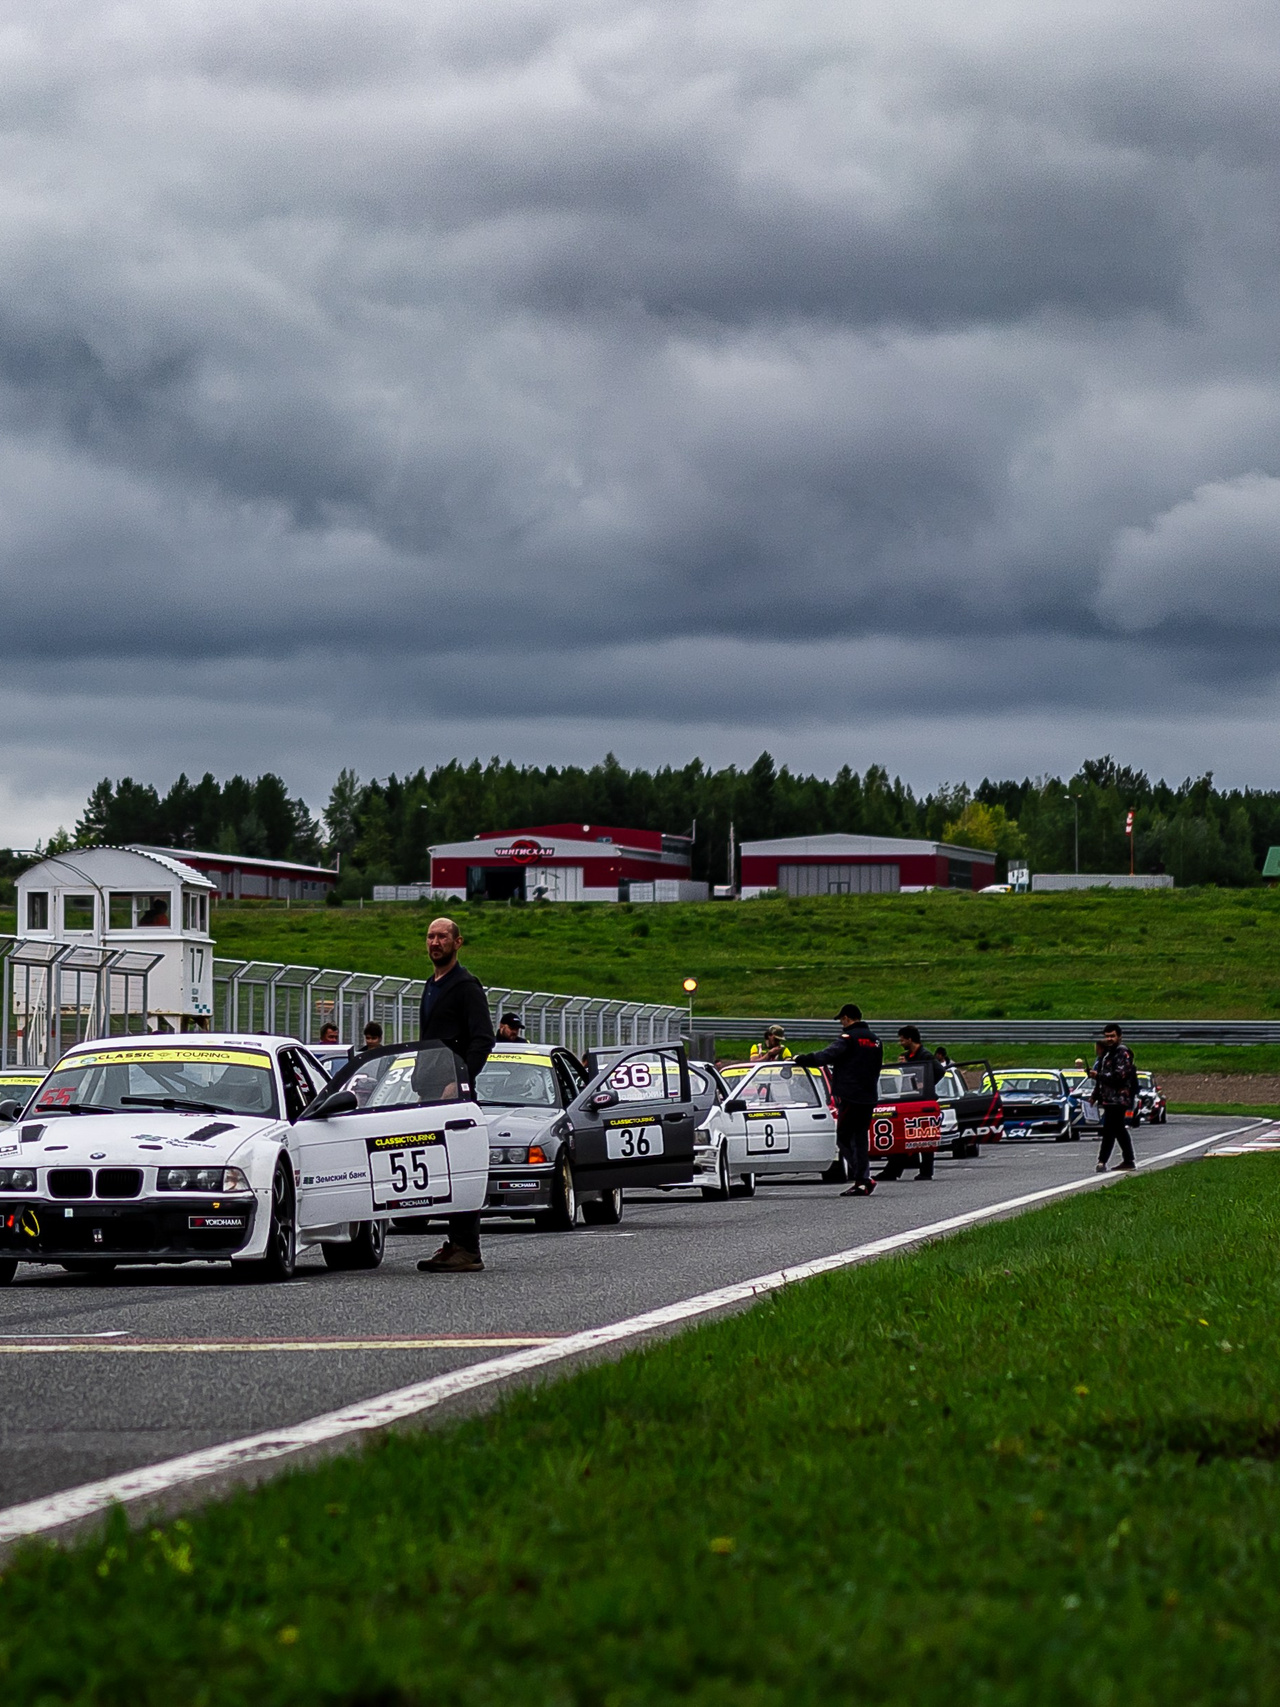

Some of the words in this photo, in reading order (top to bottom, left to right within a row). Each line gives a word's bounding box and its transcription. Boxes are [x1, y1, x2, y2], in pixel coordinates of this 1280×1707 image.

[495, 848, 553, 856] ЧИНГИСХАН
[190, 947, 204, 983] 17
[98, 1052, 154, 1061] CLASSIC
[175, 1051, 230, 1059] TOURING
[611, 1063, 651, 1089] 36
[35, 1087, 77, 1112] 55
[620, 1128, 650, 1156] 36
[765, 1124, 774, 1148] 8
[315, 1172, 347, 1184] Земский
[348, 1171, 367, 1180] банк
[389, 1150, 428, 1193] 55
[398, 1199, 430, 1207] YOKOHAMA
